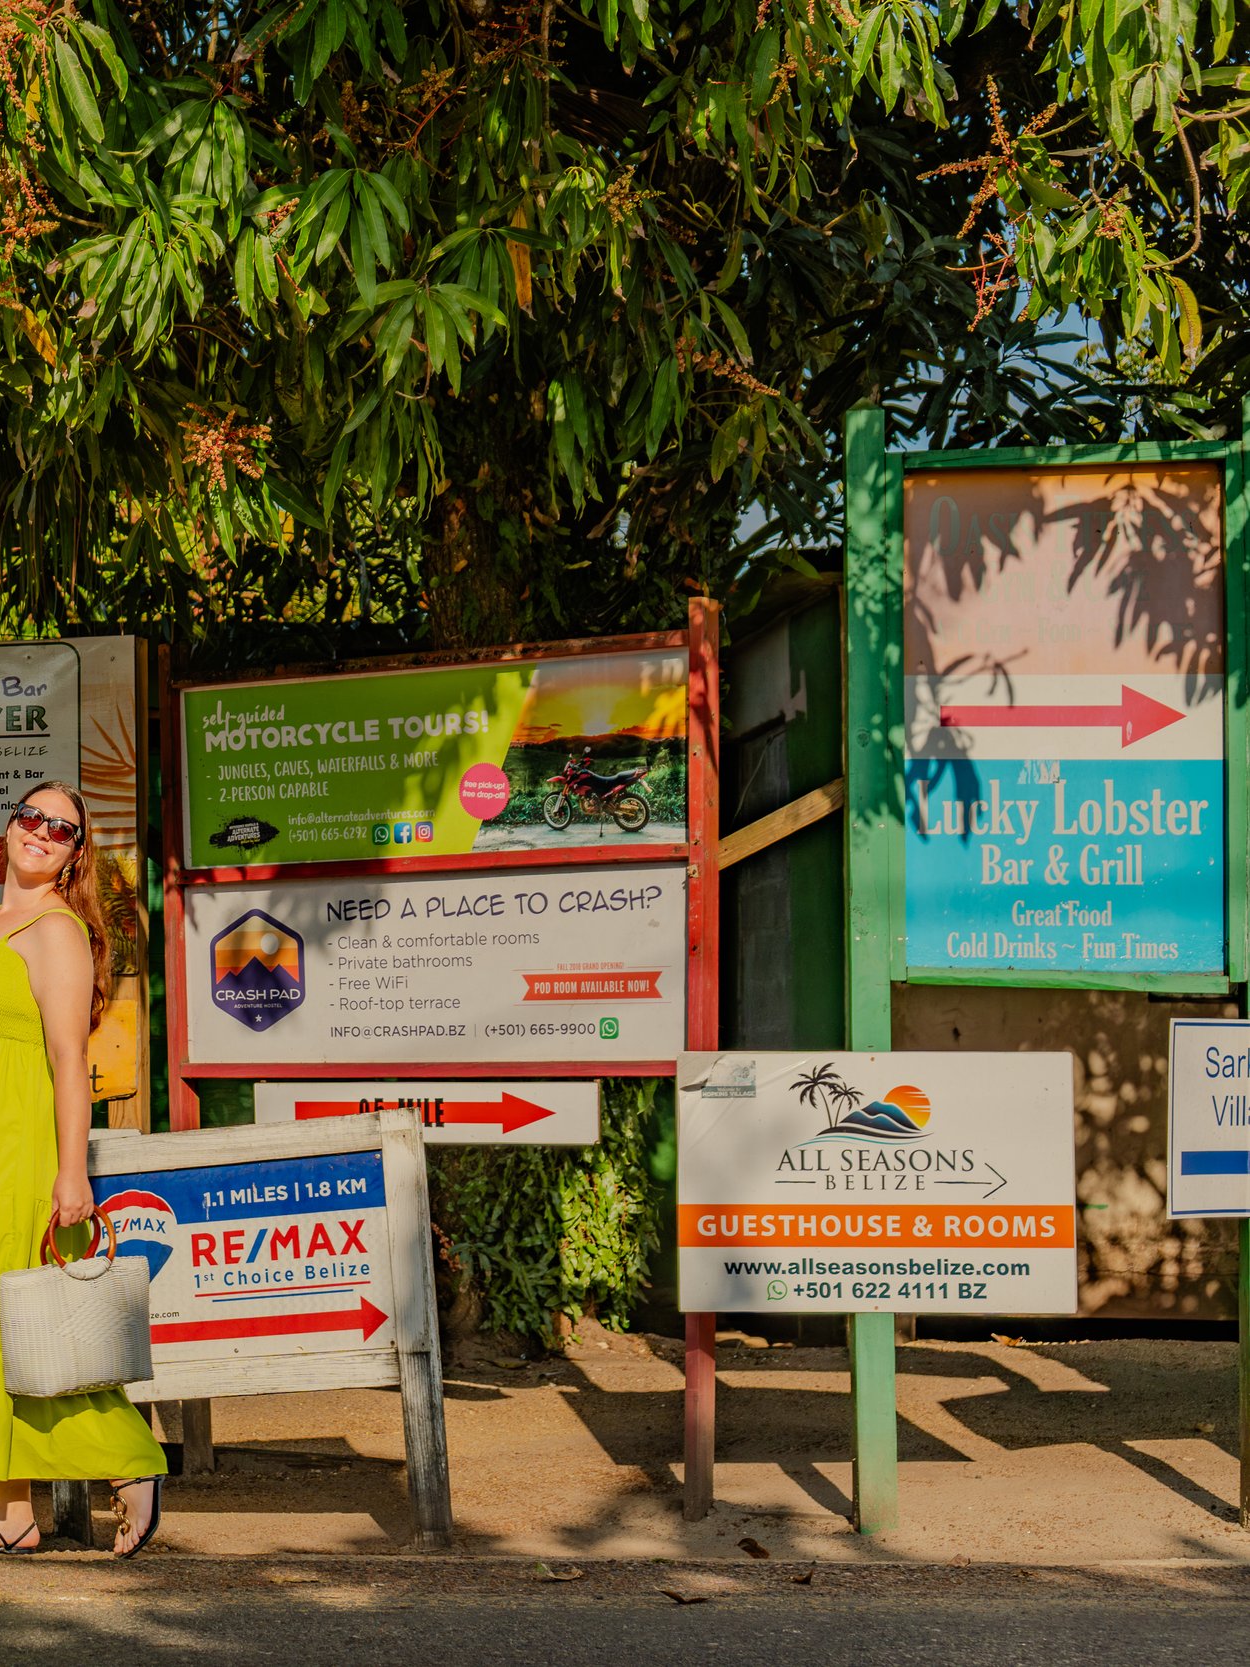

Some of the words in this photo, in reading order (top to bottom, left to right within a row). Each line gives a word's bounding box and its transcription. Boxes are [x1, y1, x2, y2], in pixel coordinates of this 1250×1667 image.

[1, 676, 48, 698] Bar
[202, 700, 286, 738] self-guided
[205, 718, 381, 753] MOTORCYCLE
[387, 710, 489, 741] TOURS!
[13, 769, 21, 779] &
[25, 769, 45, 779] Bar
[218, 762, 271, 783] JUNGLES,
[274, 759, 315, 779] CAVES,
[317, 754, 386, 775] WATERFALLS
[390, 753, 400, 769] &
[403, 751, 439, 769] MORE
[219, 784, 276, 802] 2-PERSON
[280, 781, 330, 800] CAPABLE
[288, 808, 436, 825] info@alternateadventures.com
[916, 779, 1040, 845] Lucky
[1051, 779, 1209, 836] Lobster
[288, 828, 319, 843] (+501)
[321, 826, 368, 841] 665-6292
[980, 844, 1034, 886] Bar
[1044, 844, 1070, 886] &
[1079, 844, 1144, 886] Grill
[326, 897, 392, 922] NEED
[400, 897, 418, 919] A
[426, 894, 506, 918] PLACE
[514, 891, 549, 916] TO
[559, 885, 664, 914] CRASH?
[1011, 900, 1062, 927] Great
[1067, 900, 1113, 927] Food
[337, 934, 380, 951] Clean
[382, 935, 393, 950] &
[396, 931, 489, 950] comfortable
[492, 932, 540, 946] rooms
[946, 931, 988, 959] Cold
[994, 932, 1057, 959] Drinks
[1082, 932, 1117, 960] Fun
[1121, 932, 1179, 960] Times
[338, 954, 389, 971] Private
[392, 953, 474, 969] bathrooms
[215, 989, 267, 1001] CRASH
[269, 988, 301, 1000] PAD
[338, 976, 371, 991] Free
[374, 975, 409, 990] WiFi
[534, 981, 551, 994] POD
[553, 981, 578, 994] ROOM
[580, 980, 625, 993] AVAILABLE
[627, 979, 650, 992] NOW!
[339, 995, 406, 1014] Roof-top
[408, 995, 462, 1011] terrace
[329, 1022, 467, 1040] INFO@CRASHPAD.BZ
[483, 1022, 526, 1039] (+501)
[529, 1022, 596, 1038] 665-9900
[1204, 1046, 1250, 1079] Sar
[1212, 1095, 1250, 1127] Vill
[775, 1149, 830, 1172] ALL
[839, 1148, 975, 1173] SEASONS
[203, 1189, 226, 1208] 1.1
[230, 1183, 290, 1207] MILES
[305, 1180, 332, 1199] 1.8
[336, 1176, 367, 1196] KM
[825, 1174, 927, 1191] BELIZE
[696, 1213, 902, 1238] GUESTHOUSE
[912, 1213, 934, 1238] &
[944, 1214, 1057, 1238] ROOMS
[190, 1218, 369, 1268] RE/MAX
[222, 1265, 296, 1287] Choice
[304, 1261, 372, 1280] Belize
[724, 1258, 1031, 1277] www.allseasonsbelize.com
[792, 1282, 844, 1299] +501
[850, 1282, 891, 1299] 622
[897, 1282, 949, 1300] 4111
[957, 1282, 988, 1300] BZ
